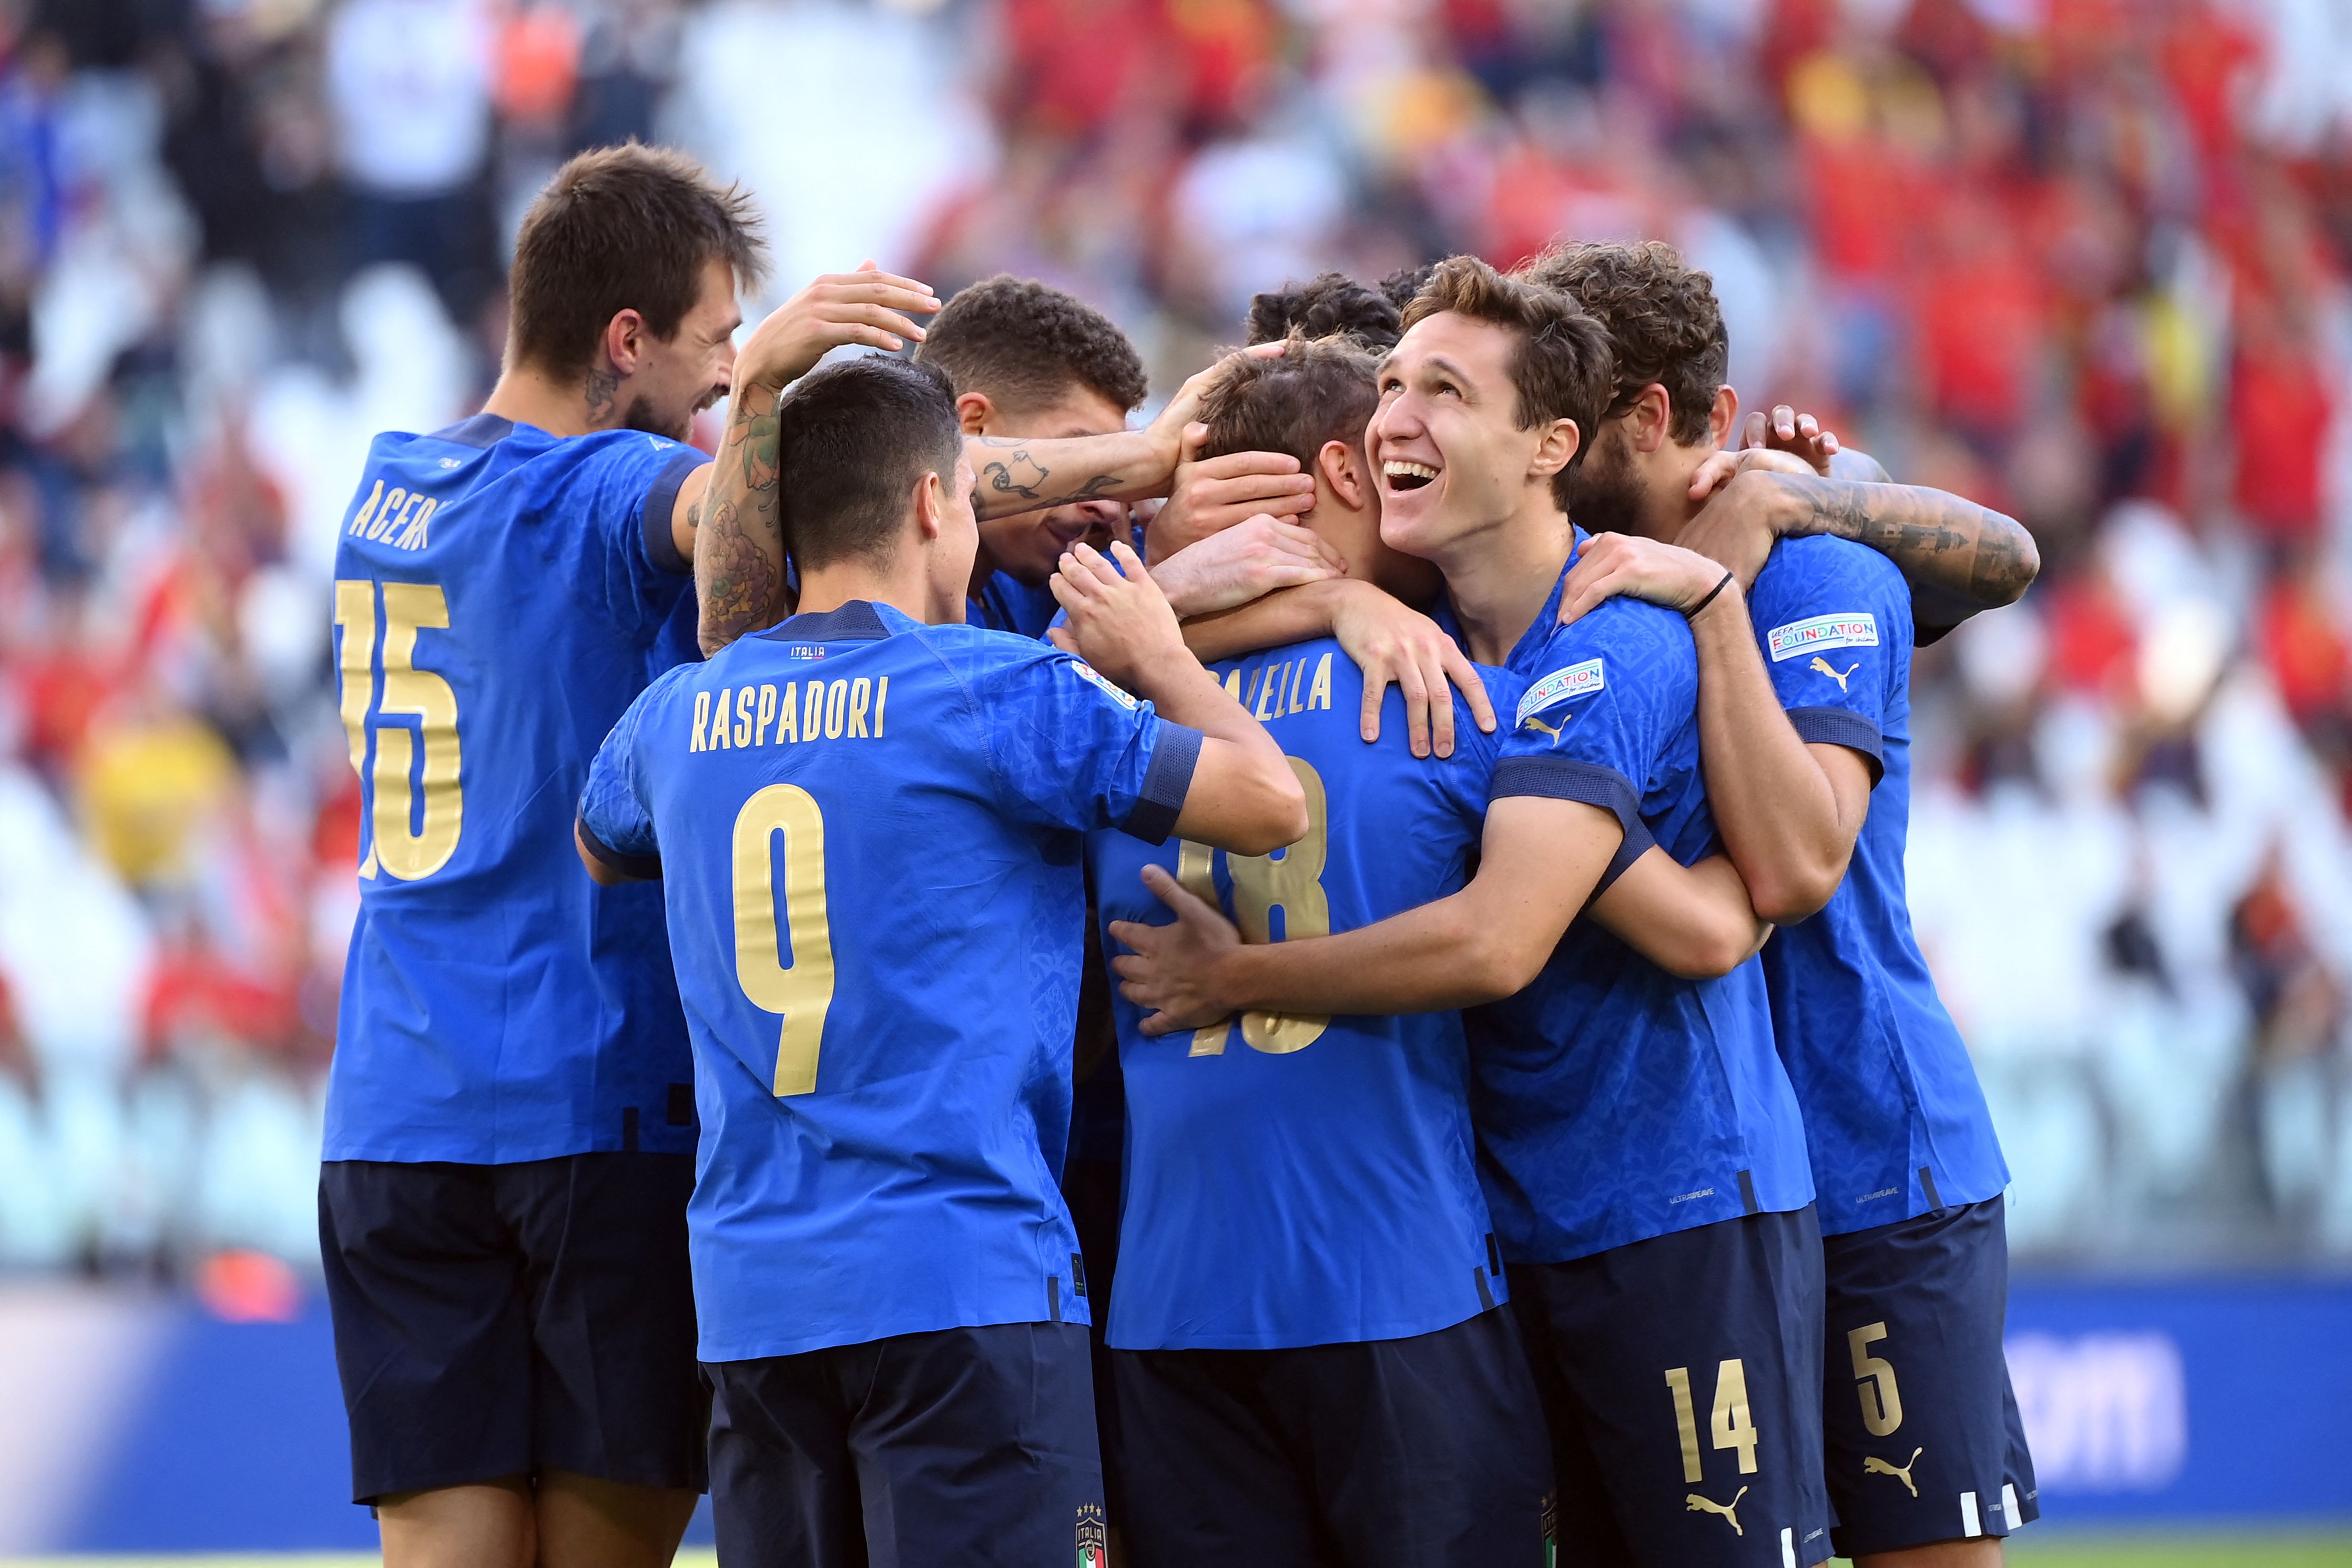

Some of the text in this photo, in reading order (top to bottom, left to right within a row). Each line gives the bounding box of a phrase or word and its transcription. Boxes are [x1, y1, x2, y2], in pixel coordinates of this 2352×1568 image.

[790, 646, 824, 657] ITALIA
[1771, 626, 1794, 638] UEFA
[1773, 623, 1874, 650] FOUNDATION
[1846, 636, 1855, 646] for
[334, 579, 462, 881] 15
[689, 676, 889, 753] RASPADORI
[731, 782, 836, 1097] 9
[1847, 1321, 1903, 1437] 5
[1664, 1358, 1758, 1483] 14
[1078, 1526, 1102, 1541] ITALIA
